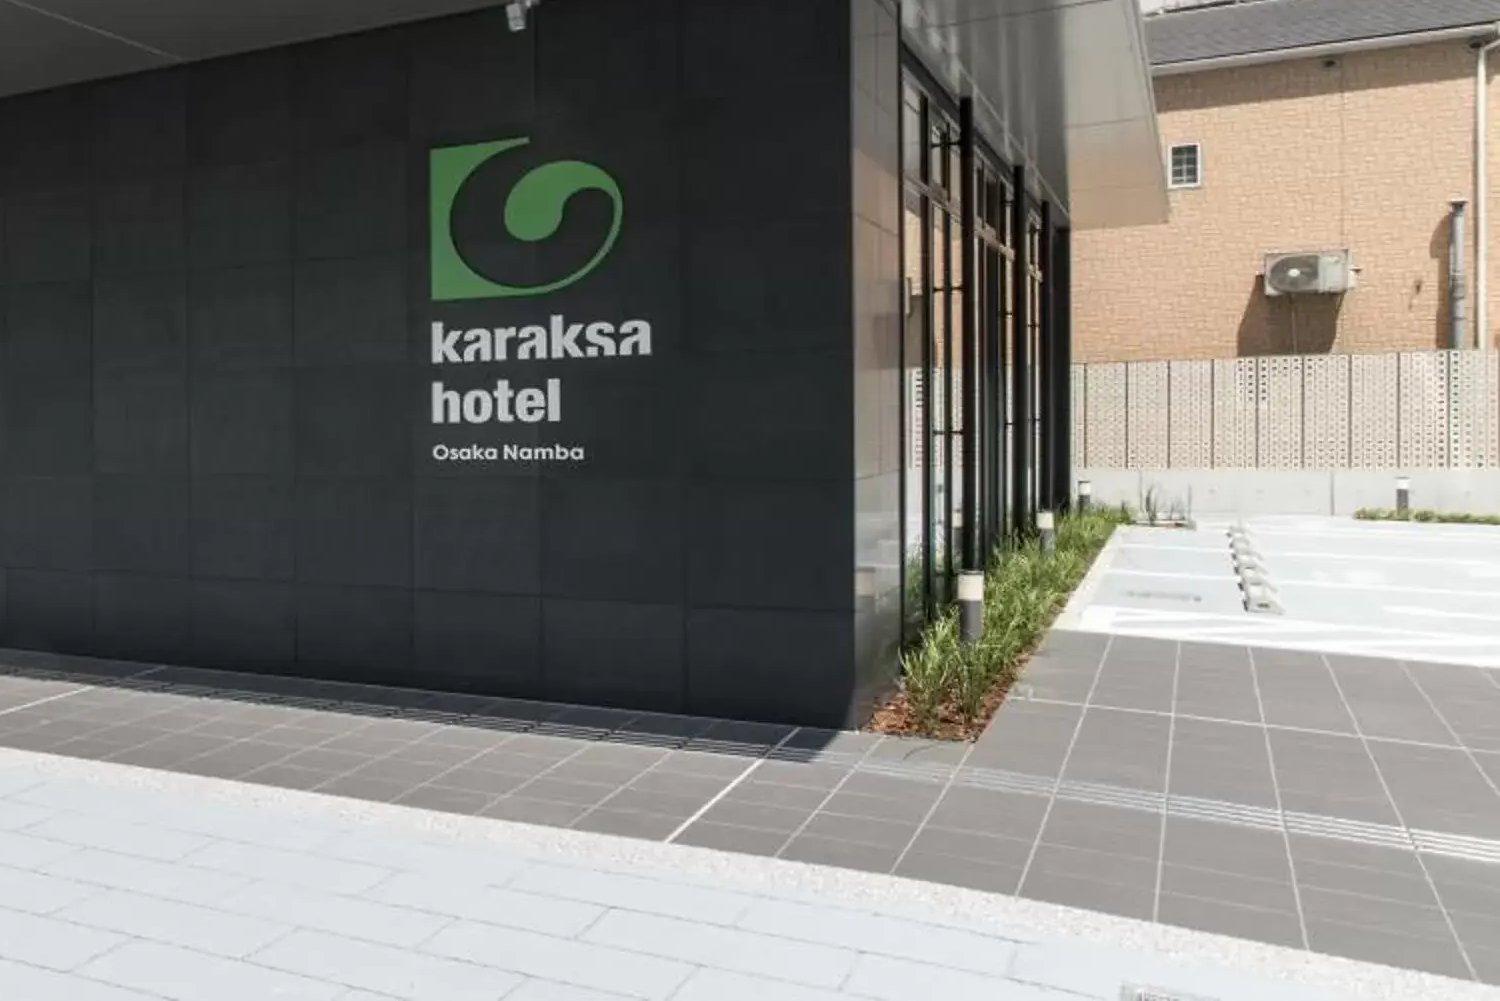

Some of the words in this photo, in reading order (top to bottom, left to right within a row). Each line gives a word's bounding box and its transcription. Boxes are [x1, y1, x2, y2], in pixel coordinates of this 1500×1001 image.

[430, 313, 652, 363] karaksa
[431, 378, 561, 424] hotel
[432, 444, 498, 460] Osaka
[503, 444, 584, 460] Namba
